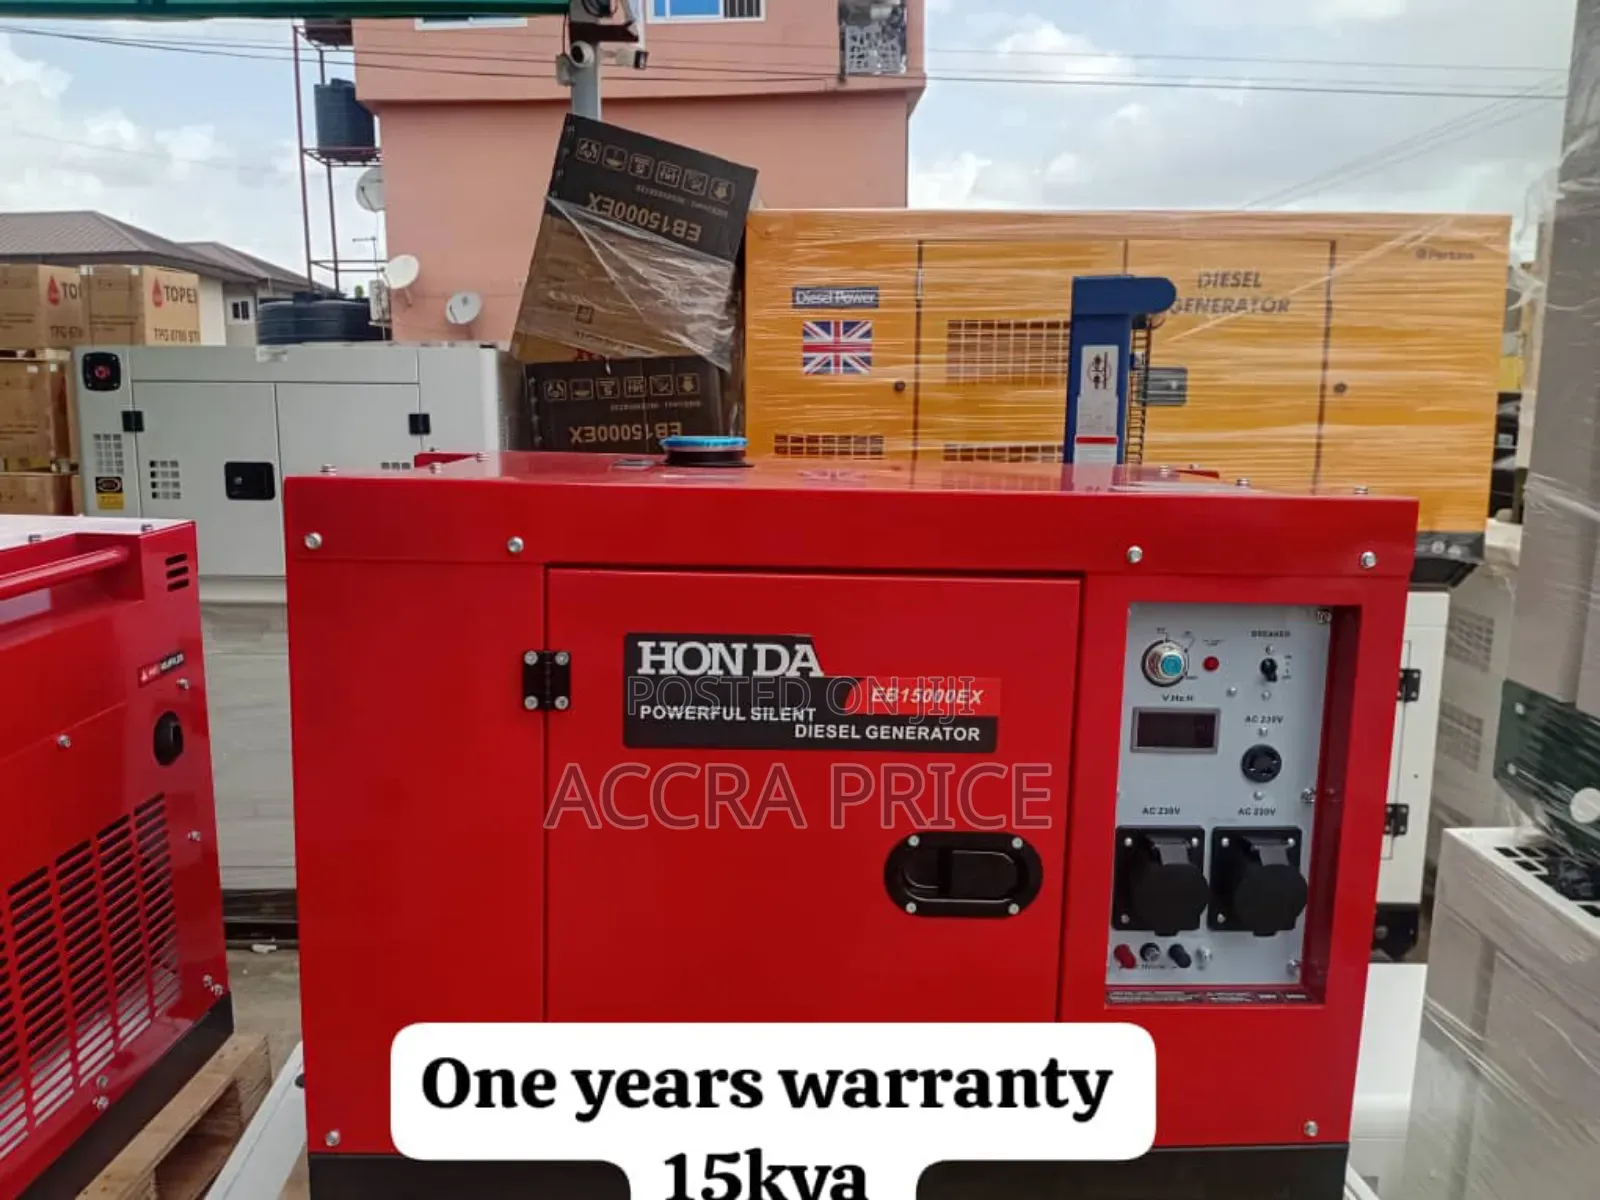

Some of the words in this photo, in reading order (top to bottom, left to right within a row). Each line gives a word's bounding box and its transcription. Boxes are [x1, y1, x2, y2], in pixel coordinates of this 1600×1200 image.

[1197, 271, 1262, 289] DIESEL
[61, 282, 82, 300] TO
[871, 687, 985, 706] EB15000EX
[640, 704, 747, 723] POWERFUL
[750, 706, 817, 723] SILENT
[794, 723, 861, 740] DIESEL
[865, 725, 981, 742] GENERATOR
